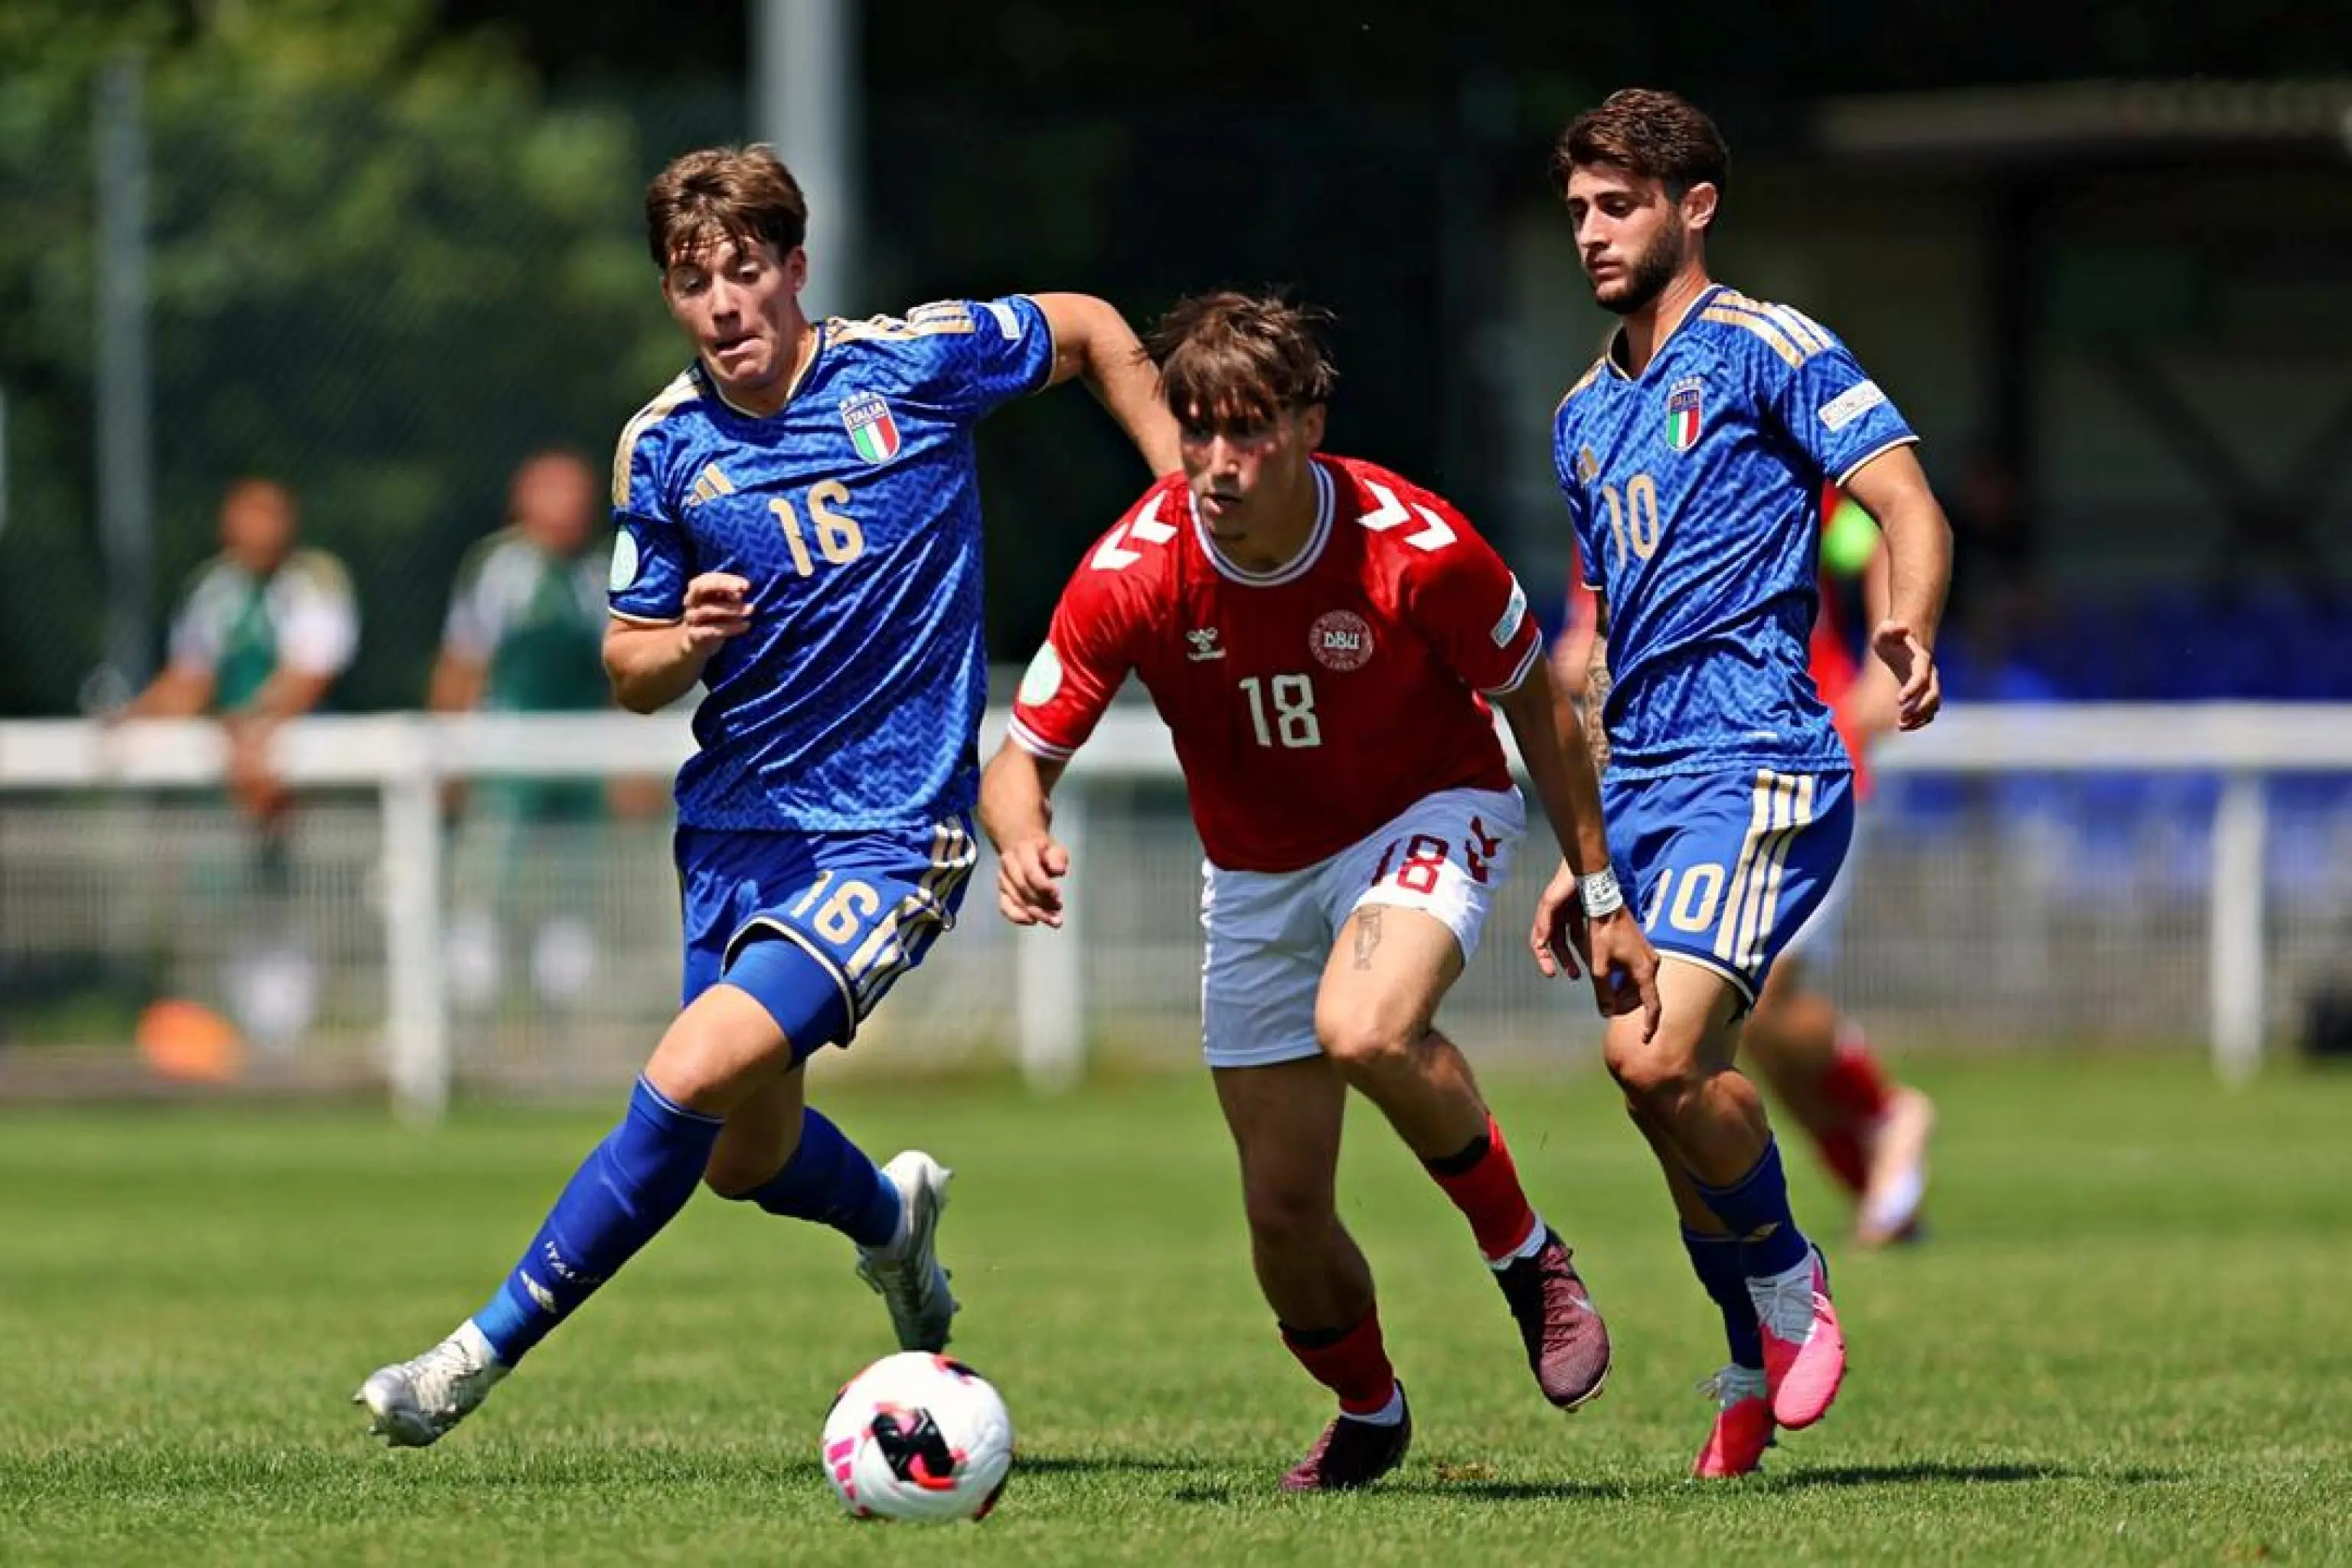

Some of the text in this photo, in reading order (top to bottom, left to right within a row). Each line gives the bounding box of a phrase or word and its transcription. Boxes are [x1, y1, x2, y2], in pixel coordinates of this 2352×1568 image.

[769, 479, 864, 577] 16
[1604, 474, 1658, 570] 10
[1323, 631, 1359, 649] DBU
[1239, 672, 1322, 747] 18
[1371, 834, 1449, 895] 18
[1643, 863, 1725, 933] 10
[789, 870, 880, 944] 16
